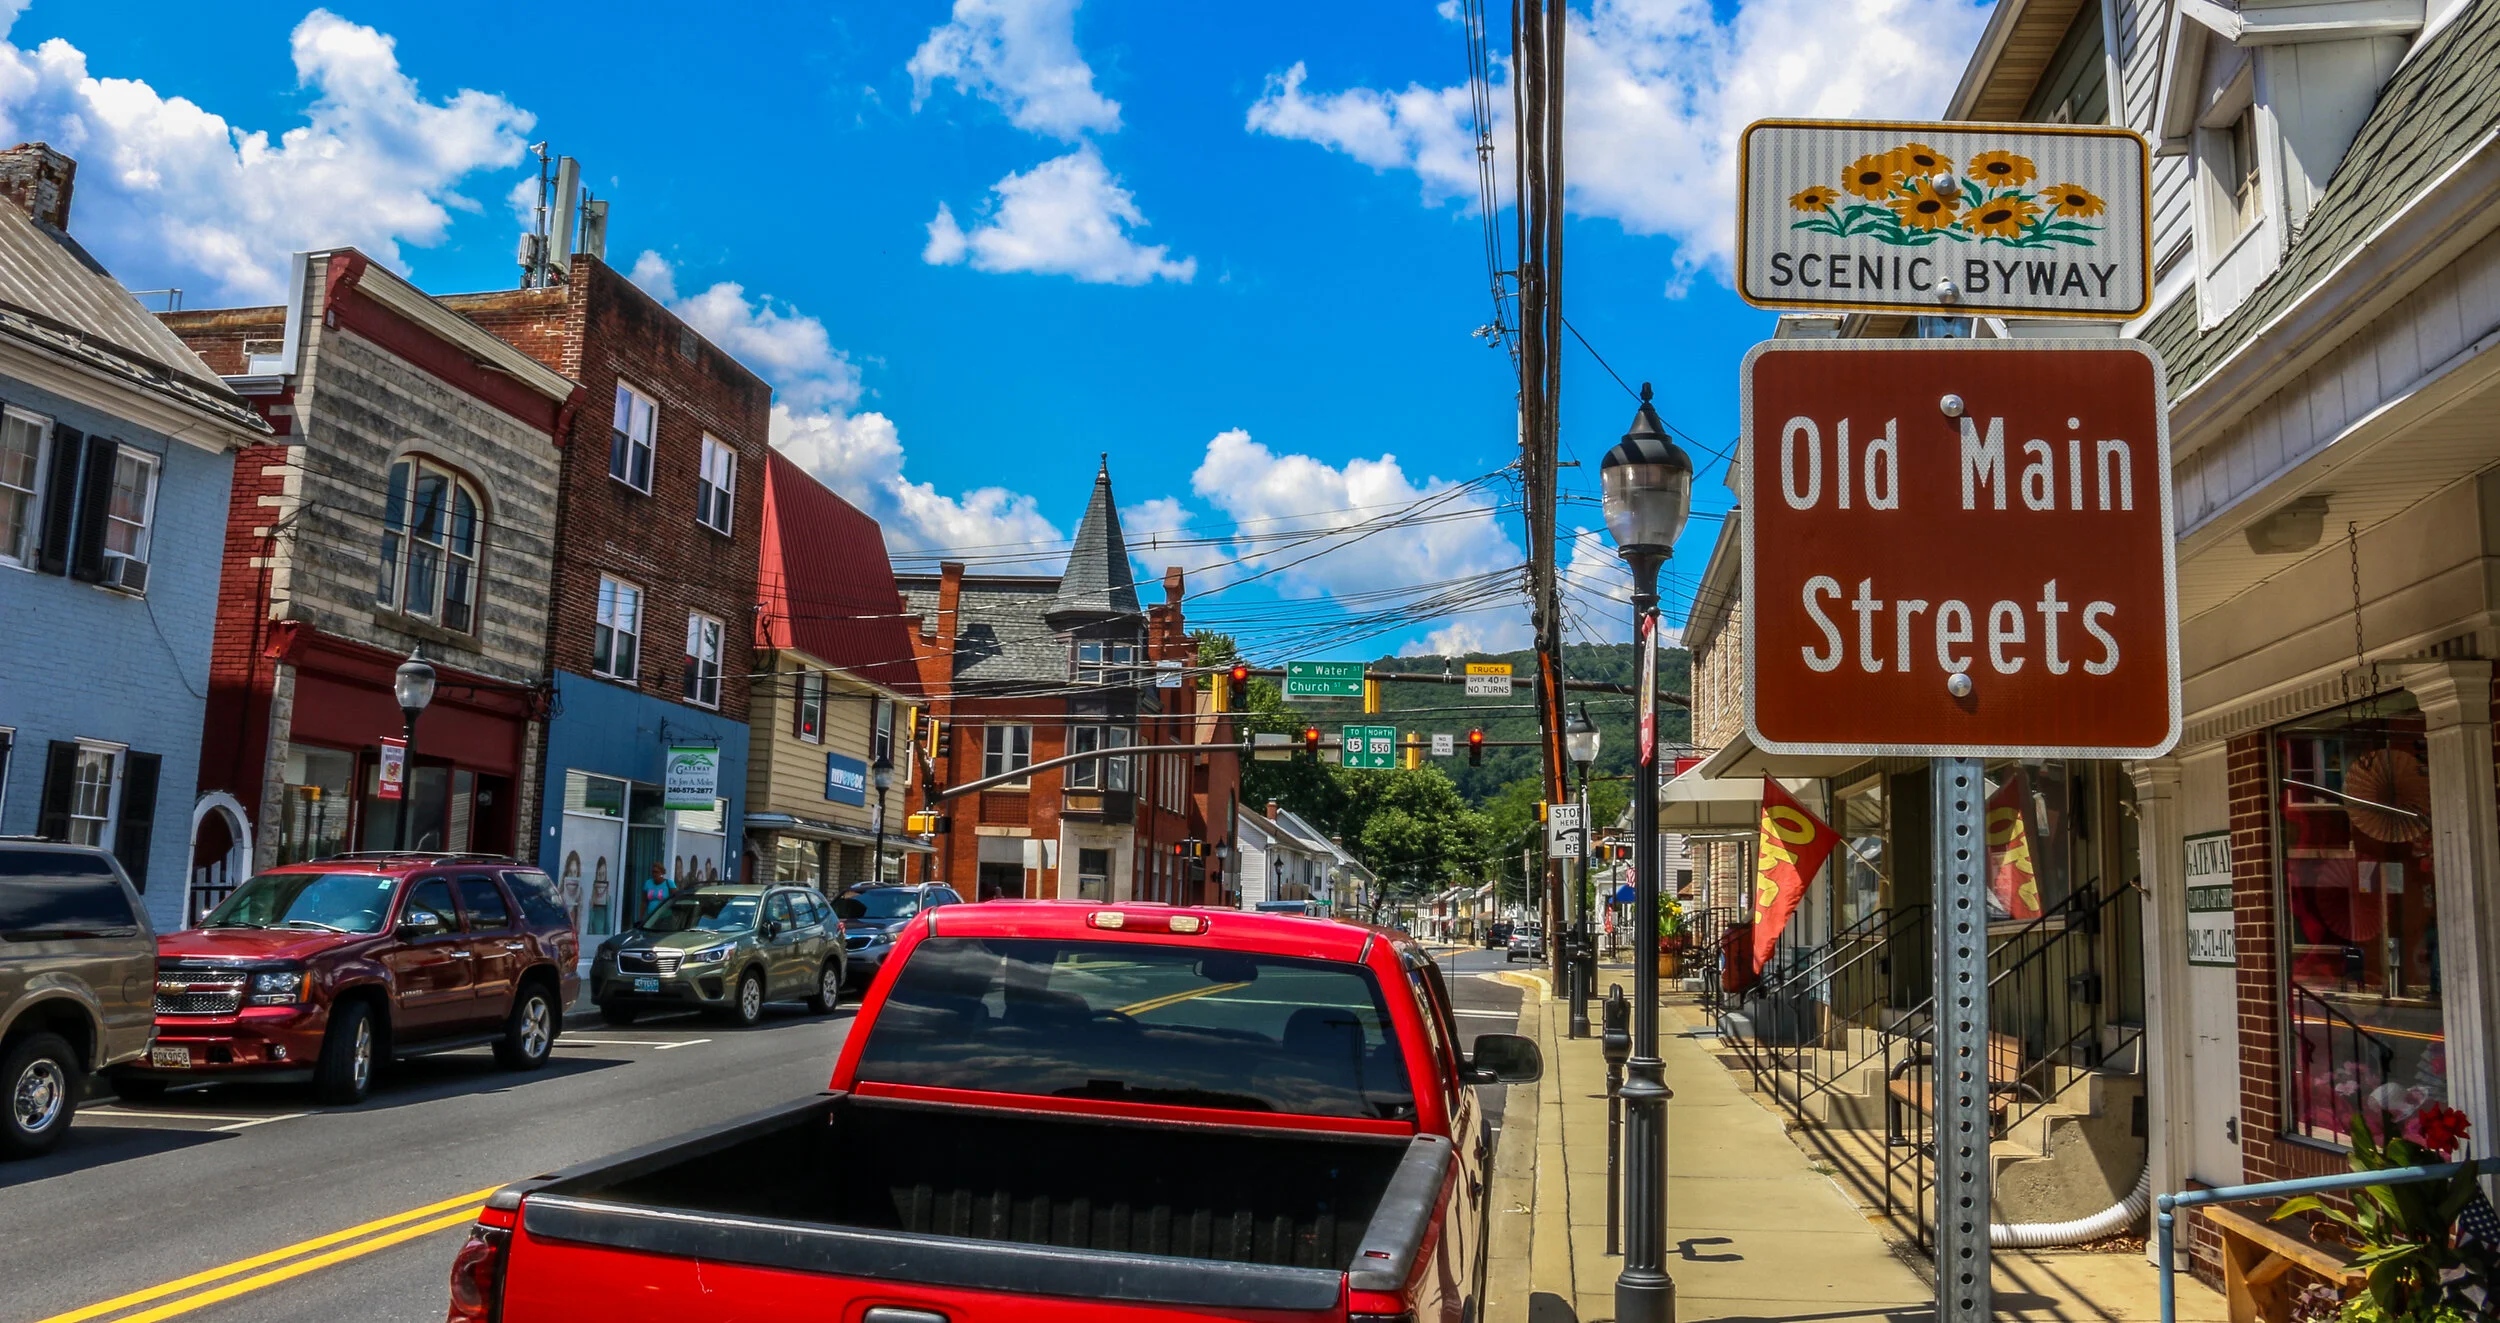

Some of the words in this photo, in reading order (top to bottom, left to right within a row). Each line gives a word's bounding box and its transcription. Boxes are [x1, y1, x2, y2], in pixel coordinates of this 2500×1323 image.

[1769, 252, 1932, 291] SCENIC
[1965, 259, 2118, 297] BYWAY
[1781, 415, 1899, 510] Old
[1960, 416, 2133, 511] Main
[1801, 575, 2120, 675] Streets
[1315, 665, 1348, 675] Water
[1488, 676, 1499, 684] 40
[1290, 681, 1330, 692] Church
[1467, 685, 1480, 693] NO
[1483, 685, 1509, 694] TURNS
[1350, 728, 1360, 736] TO
[1349, 740, 1360, 750] 15
[1371, 743, 1389, 753] 550
[675, 765, 710, 775] GATEWAY
[668, 786, 714, 794] 240-575-2877
[1565, 843, 1580, 853] RE
[2185, 839, 2232, 876] GATEWAY
